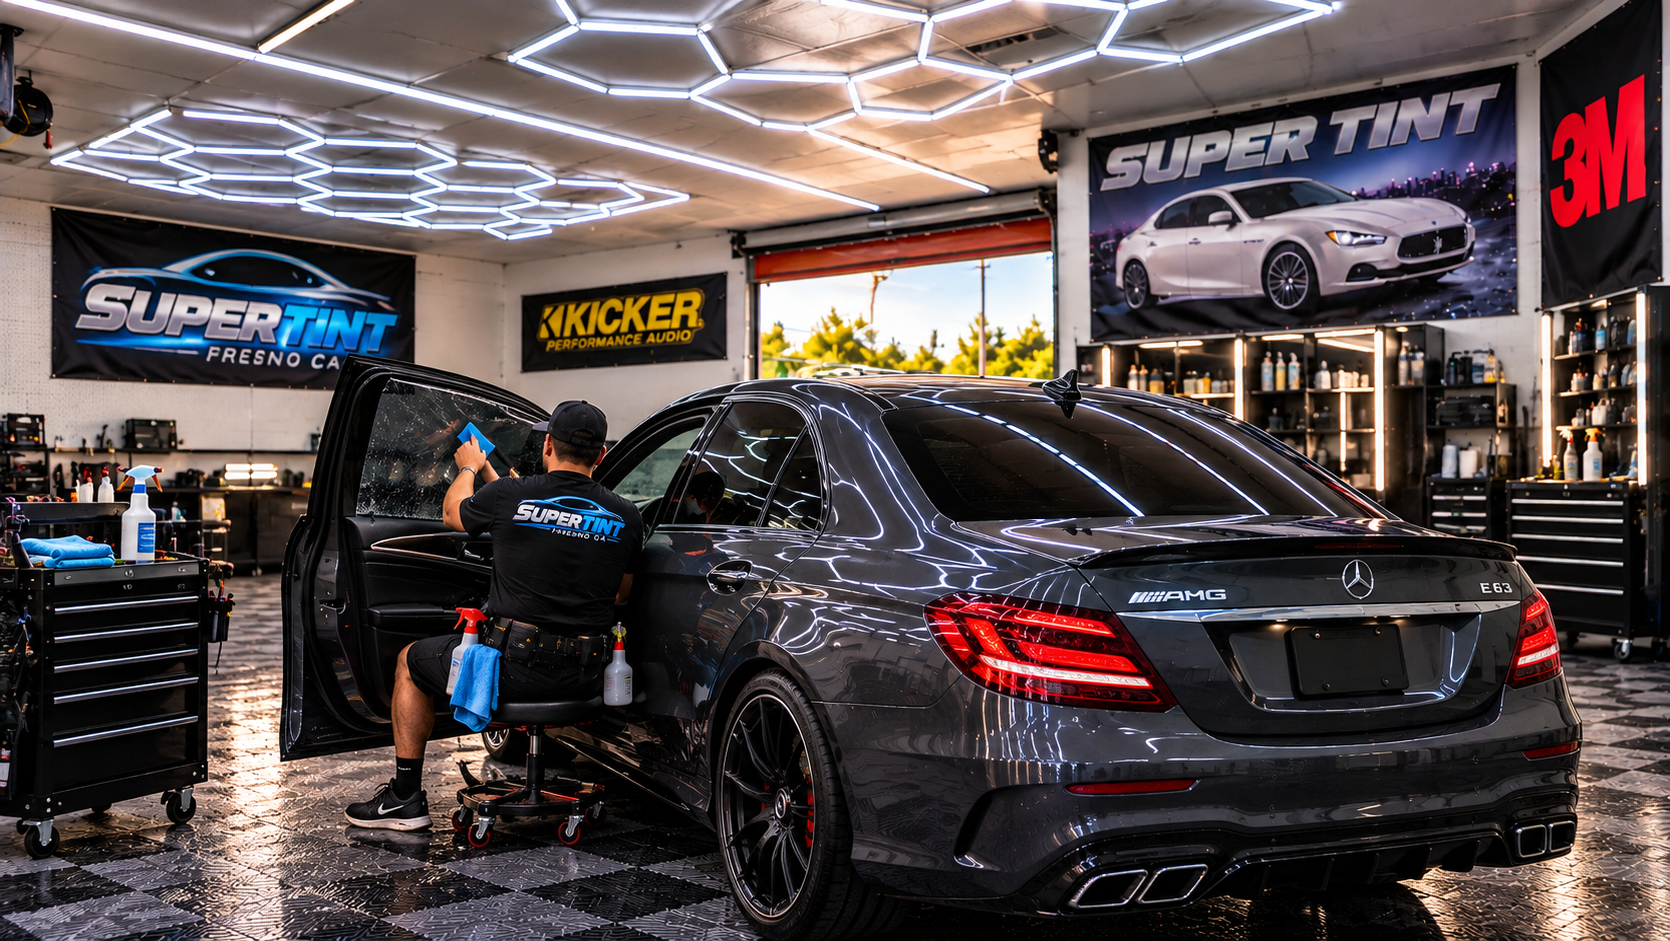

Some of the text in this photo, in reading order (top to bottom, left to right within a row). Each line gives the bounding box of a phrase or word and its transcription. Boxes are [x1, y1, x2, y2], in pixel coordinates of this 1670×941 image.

[1100, 83, 1501, 192] SUPER TINT
[1550, 73, 1647, 228] 3M
[545, 329, 692, 353] PERFORMANCE AUDIO
[206, 345, 340, 370] FRESNO CA
[1162, 589, 1227, 602] AMG
